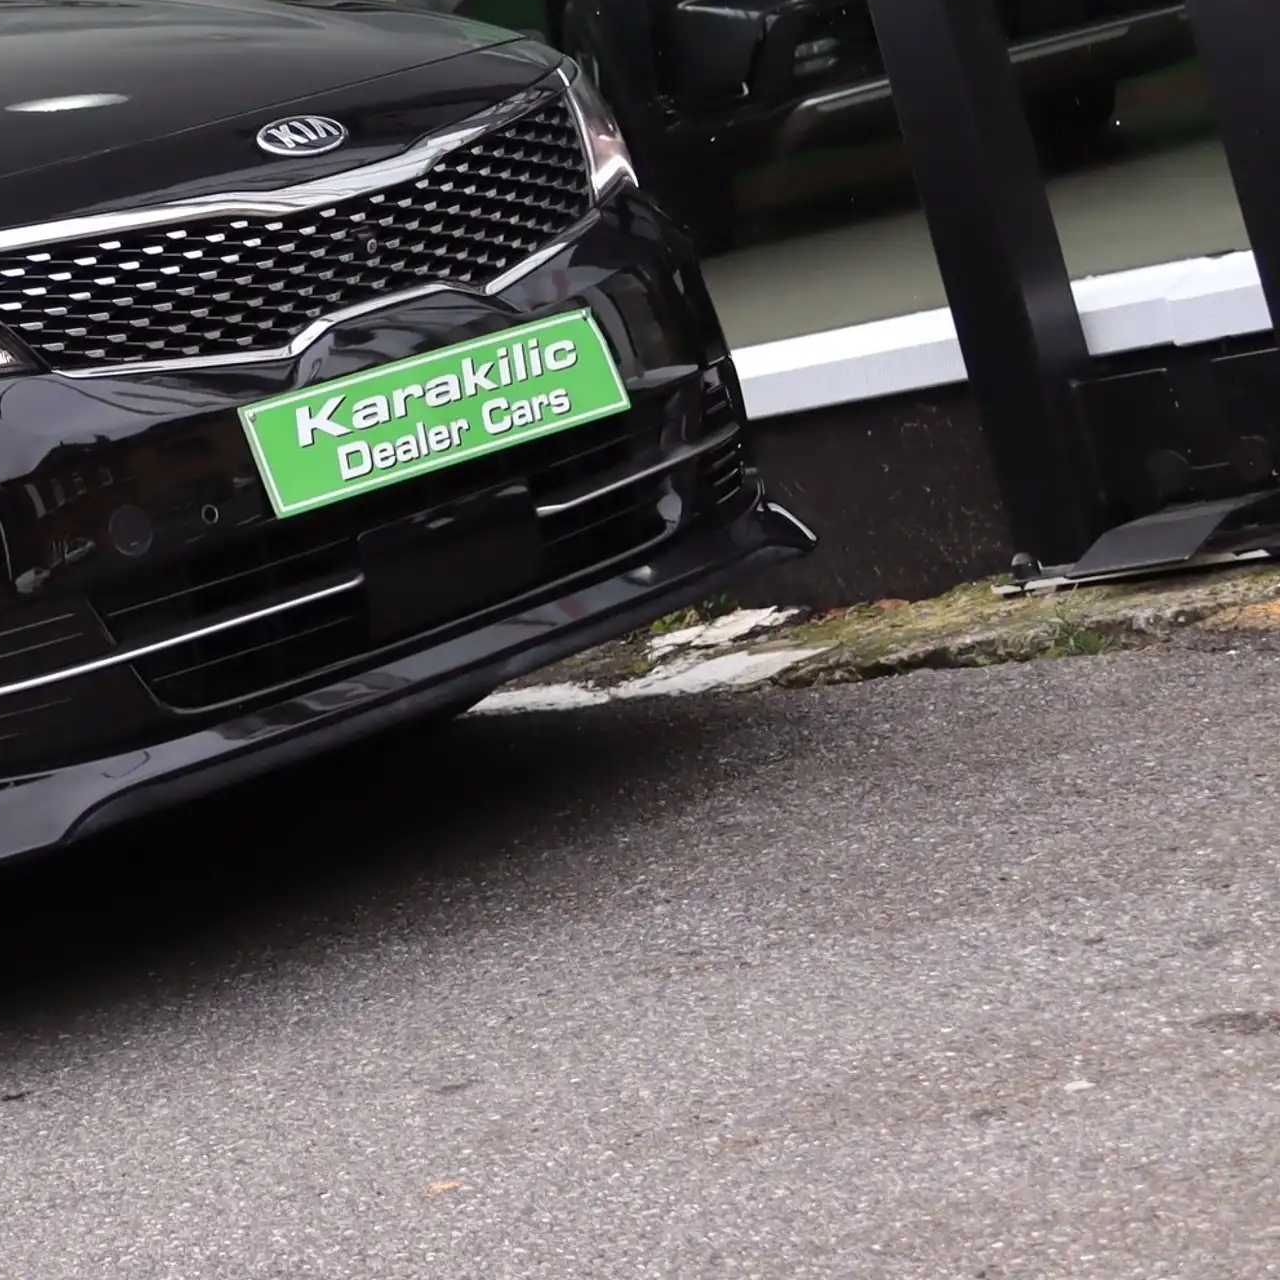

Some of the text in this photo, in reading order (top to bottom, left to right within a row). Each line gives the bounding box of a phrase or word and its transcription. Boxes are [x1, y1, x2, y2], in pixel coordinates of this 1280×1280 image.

[267, 118, 341, 149] KIA
[295, 338, 578, 448] Karakilic
[337, 388, 571, 481] Dealer Cars
